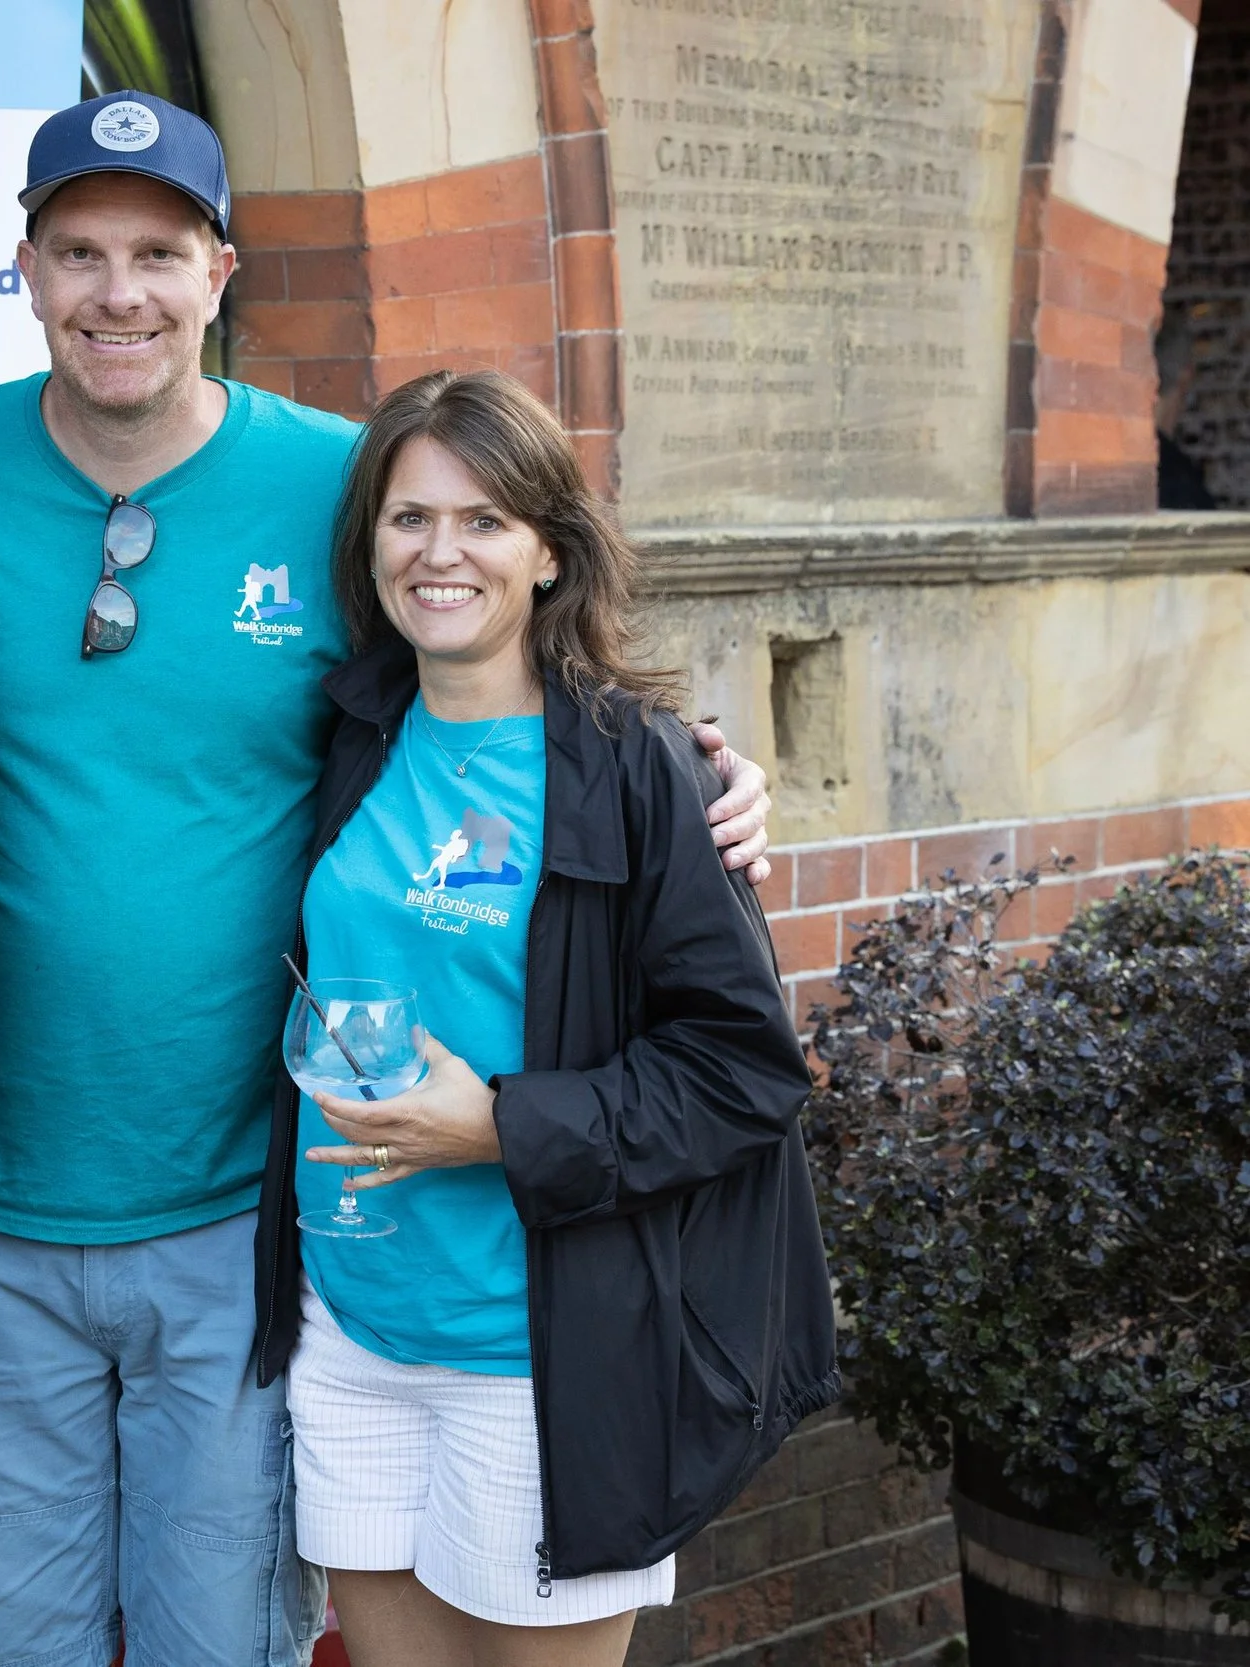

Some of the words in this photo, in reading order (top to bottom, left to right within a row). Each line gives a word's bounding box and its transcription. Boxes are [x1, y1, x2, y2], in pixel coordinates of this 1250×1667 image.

[675, 44, 830, 98] MEMORIAL
[843, 61, 946, 108] STONES
[108, 106, 147, 119] DALLAS
[103, 130, 146, 142] COWBOYS
[251, 633, 284, 646] Festival
[420, 908, 469, 936] Festival
